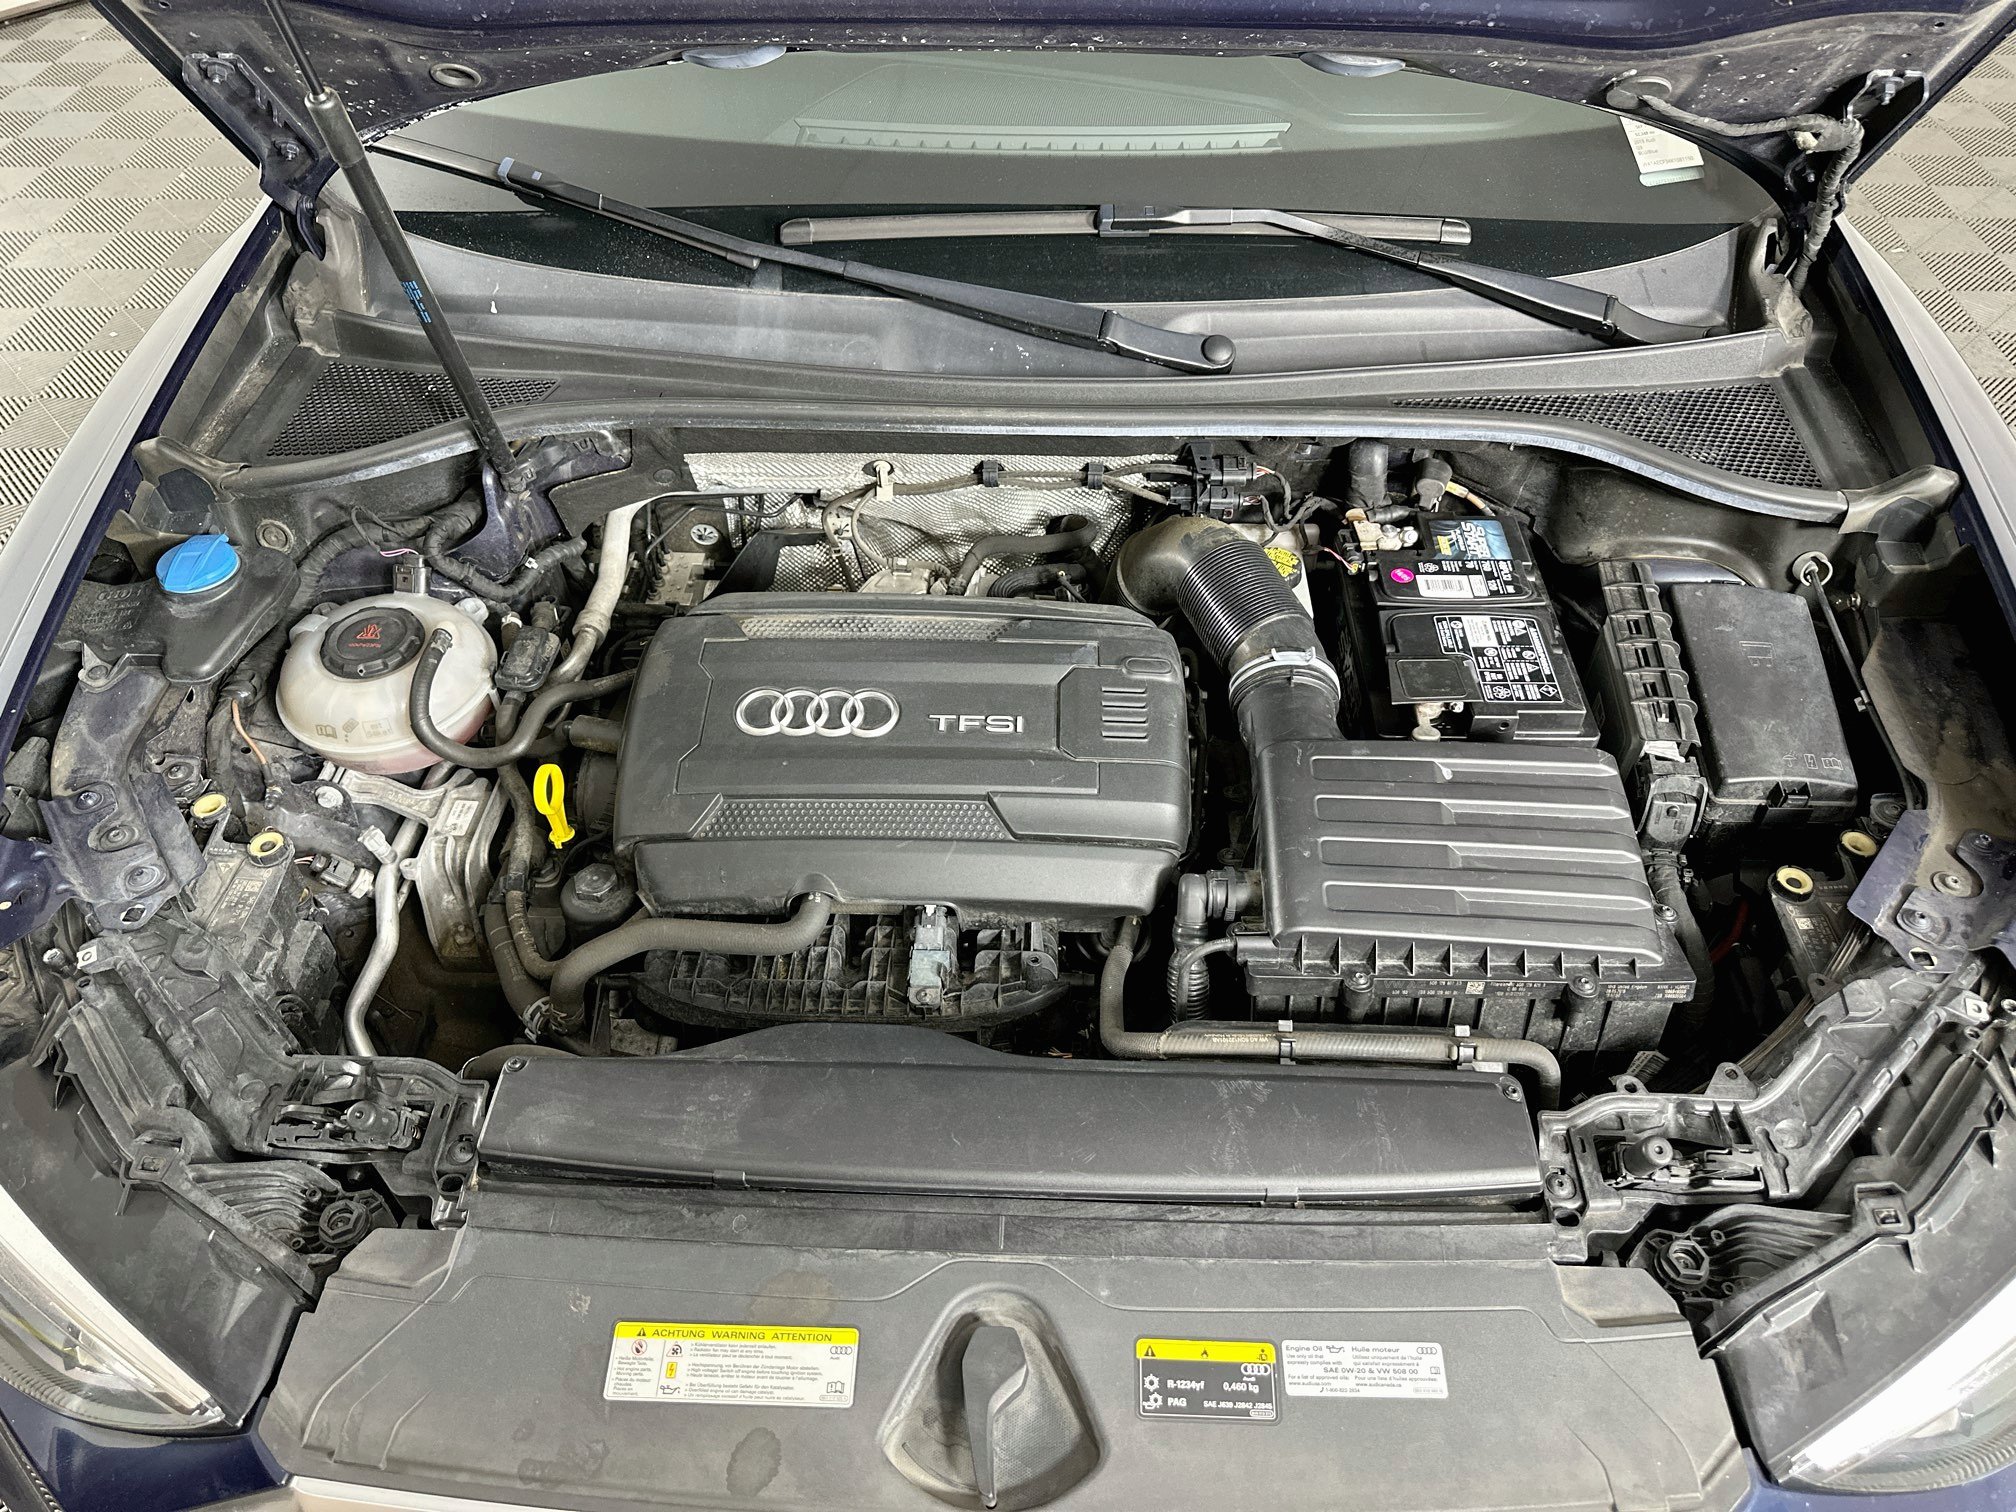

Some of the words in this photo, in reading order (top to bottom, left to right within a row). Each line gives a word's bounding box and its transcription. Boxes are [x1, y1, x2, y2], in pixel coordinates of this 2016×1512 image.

[1461, 521, 1480, 556] START
[1476, 525, 1492, 558] SUPER
[929, 714, 1024, 734] TFSI
[652, 1328, 705, 1339] ACHTUNG
[712, 1330, 766, 1340] WARNING
[771, 1331, 832, 1341] ATTENTION
[1167, 1379, 1206, 1391] R-1234yf
[1248, 1383, 1260, 1394] kg
[1167, 1397, 1187, 1407] PAG
[1203, 1400, 1217, 1408] SAE
